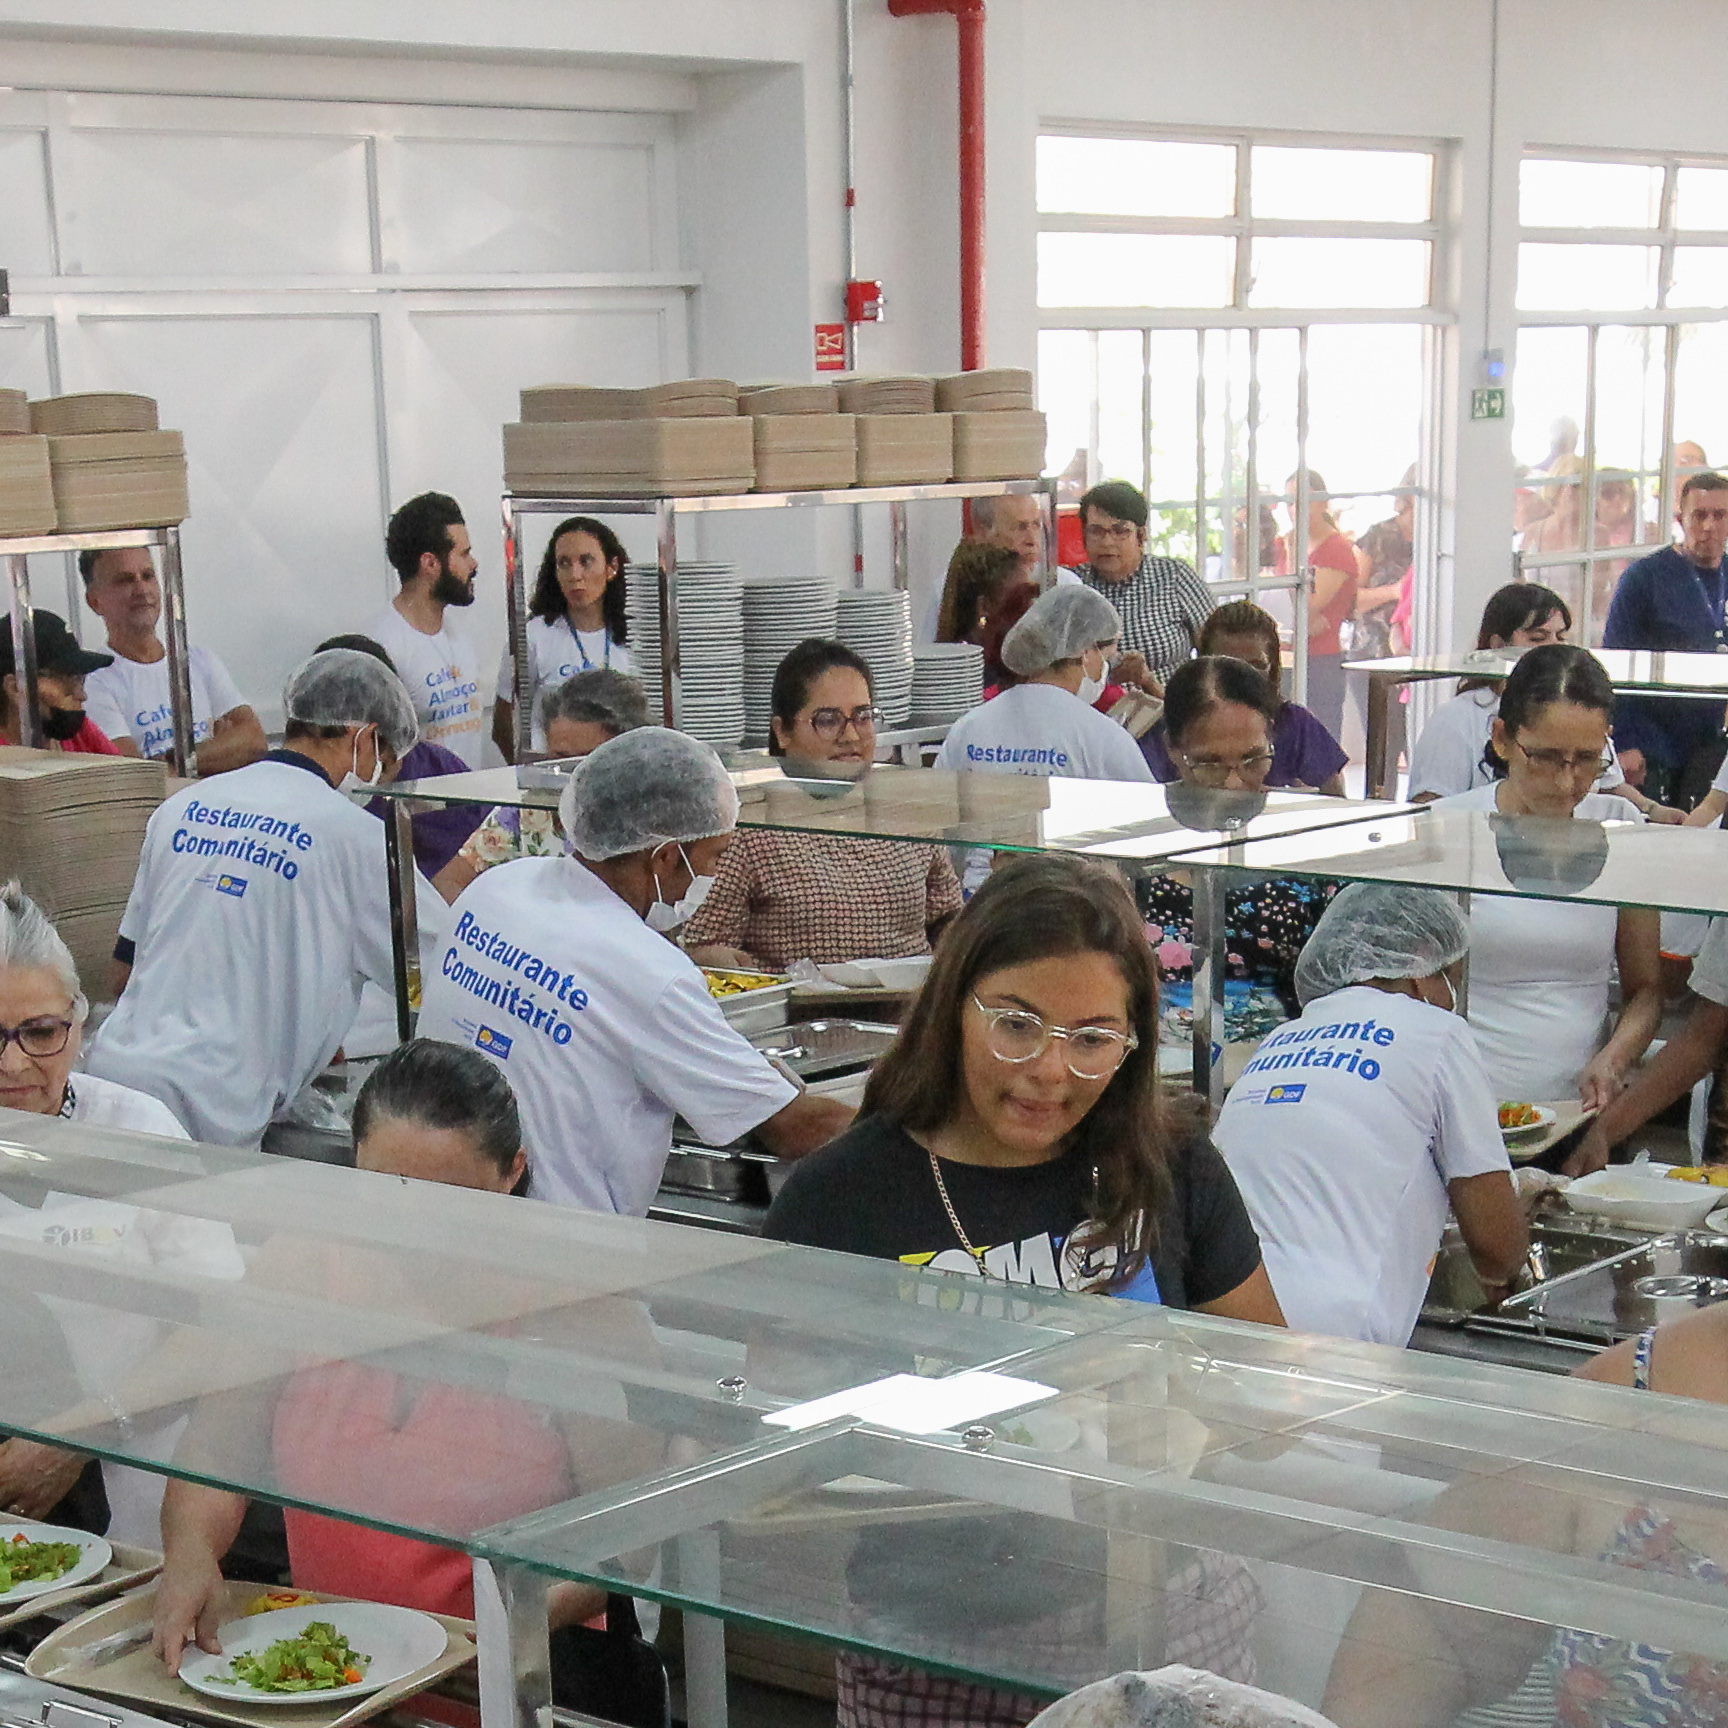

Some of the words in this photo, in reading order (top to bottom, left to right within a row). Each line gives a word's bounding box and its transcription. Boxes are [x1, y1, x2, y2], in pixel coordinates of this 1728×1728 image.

[143, 720, 209, 748] Almço
[967, 744, 1068, 767] Restaurante
[182, 800, 313, 851] Restaurante
[454, 910, 589, 1012] Restaurante
[442, 946, 573, 1046] Comunitário
[1261, 1019, 1396, 1048] taurante
[1242, 1045, 1381, 1081] munitário
